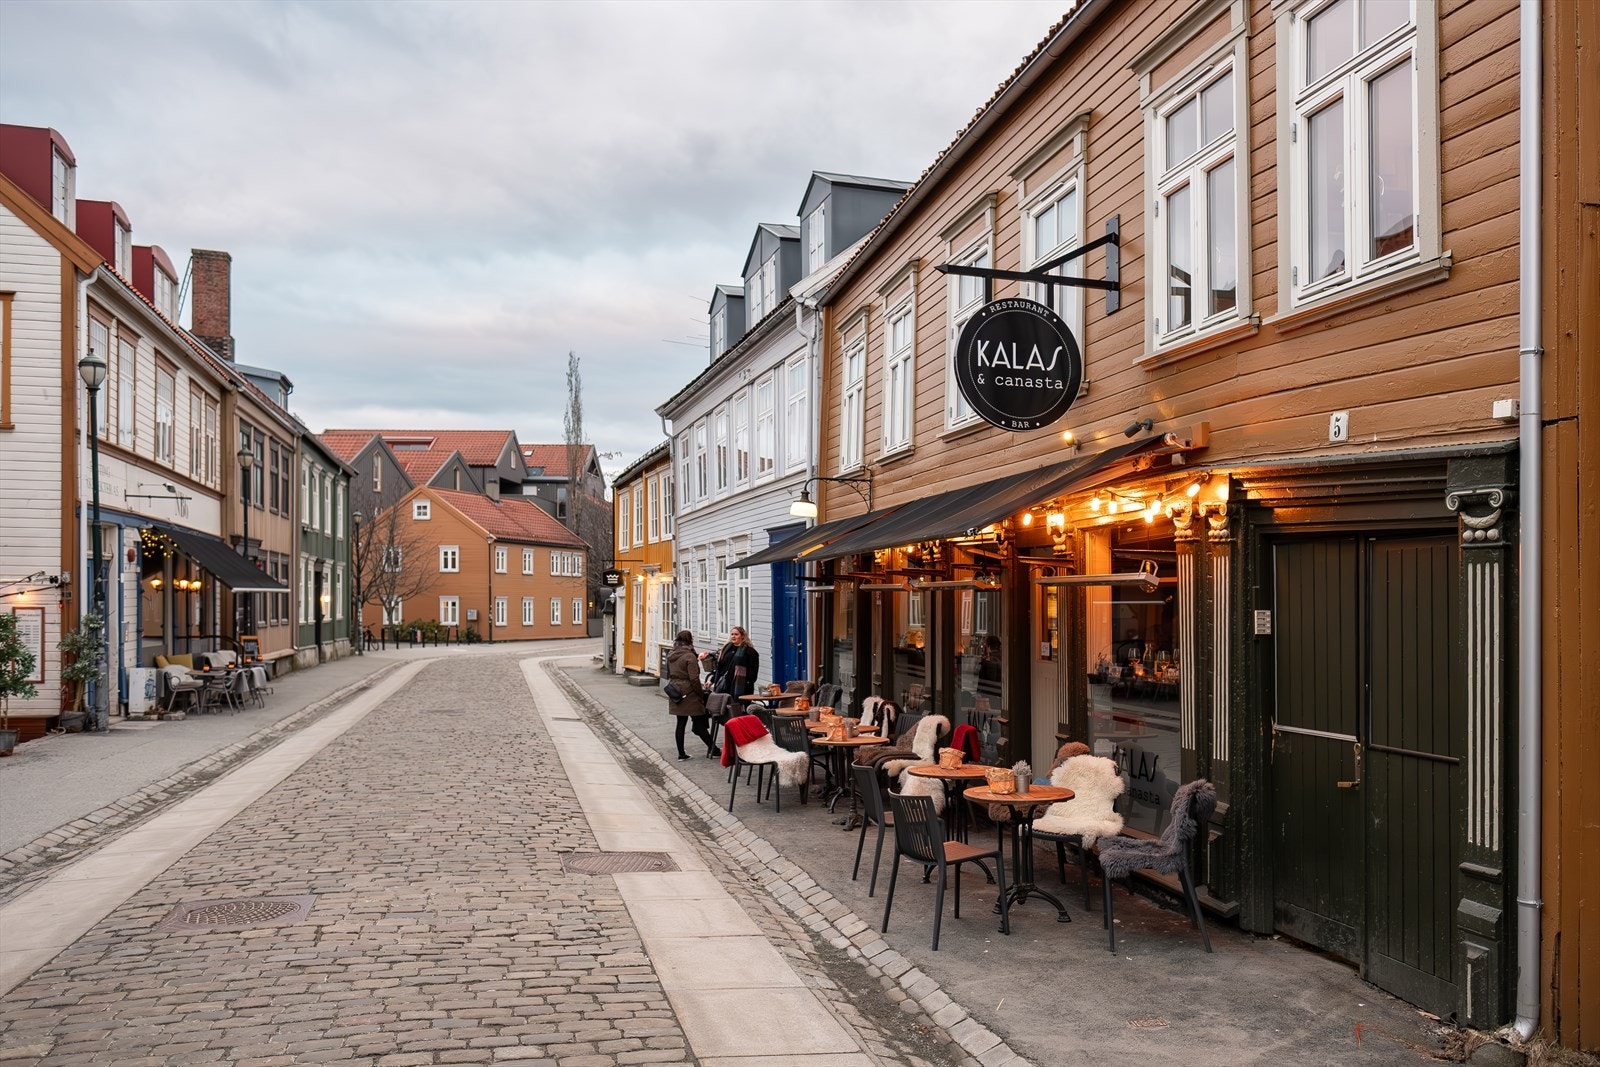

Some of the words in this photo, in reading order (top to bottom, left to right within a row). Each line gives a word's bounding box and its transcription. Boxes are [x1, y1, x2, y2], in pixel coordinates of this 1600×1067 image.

[989, 301, 1050, 317] RESTAURANT
[977, 339, 1063, 371] KALAS
[977, 373, 985, 385] &
[994, 375, 1064, 390] canasta
[1011, 420, 1030, 428] BAR
[1333, 416, 1342, 438] 5
[1126, 786, 1161, 805] anasta
